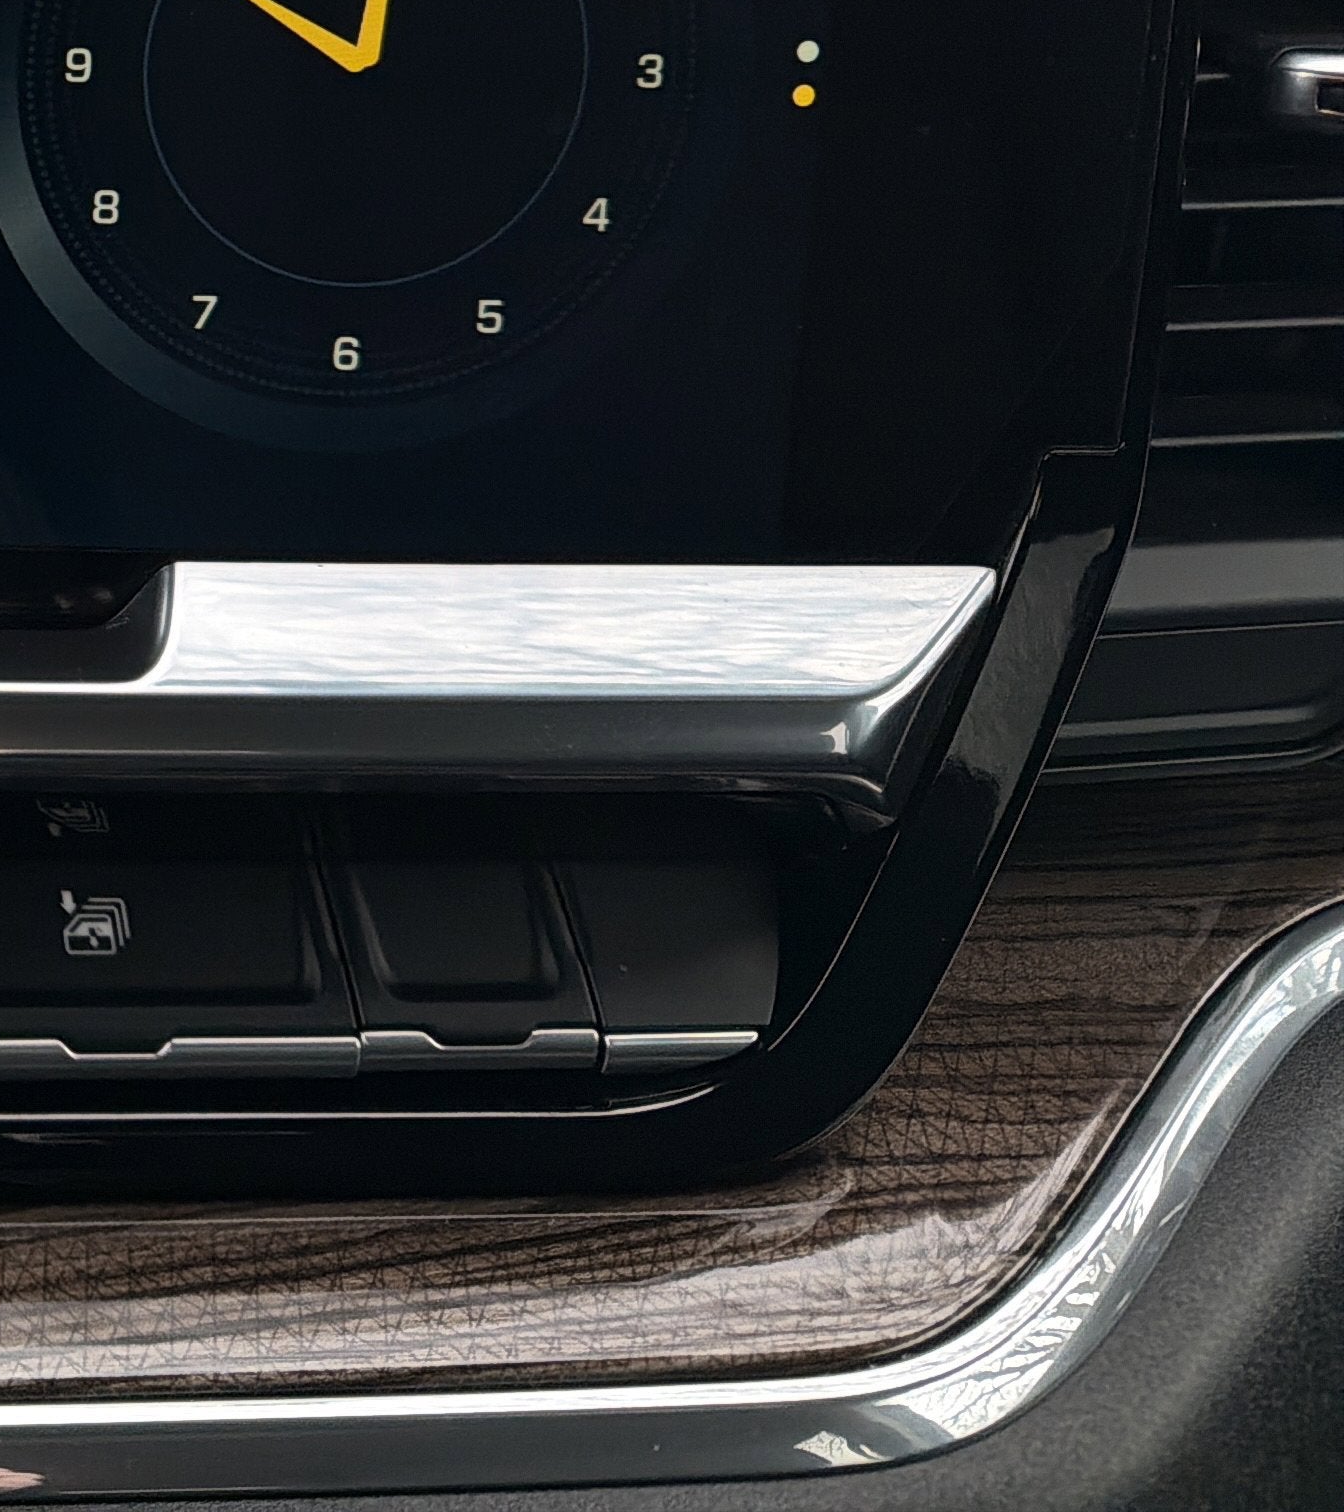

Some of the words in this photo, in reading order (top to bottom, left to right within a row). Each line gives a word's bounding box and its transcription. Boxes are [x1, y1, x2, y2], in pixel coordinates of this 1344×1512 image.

[64, 47, 92, 83] 9
[636, 53, 664, 89] 3
[92, 189, 120, 225] 8
[582, 197, 610, 232] 4
[192, 295, 218, 330] 7
[476, 299, 503, 334] 5
[332, 336, 359, 371] 6
